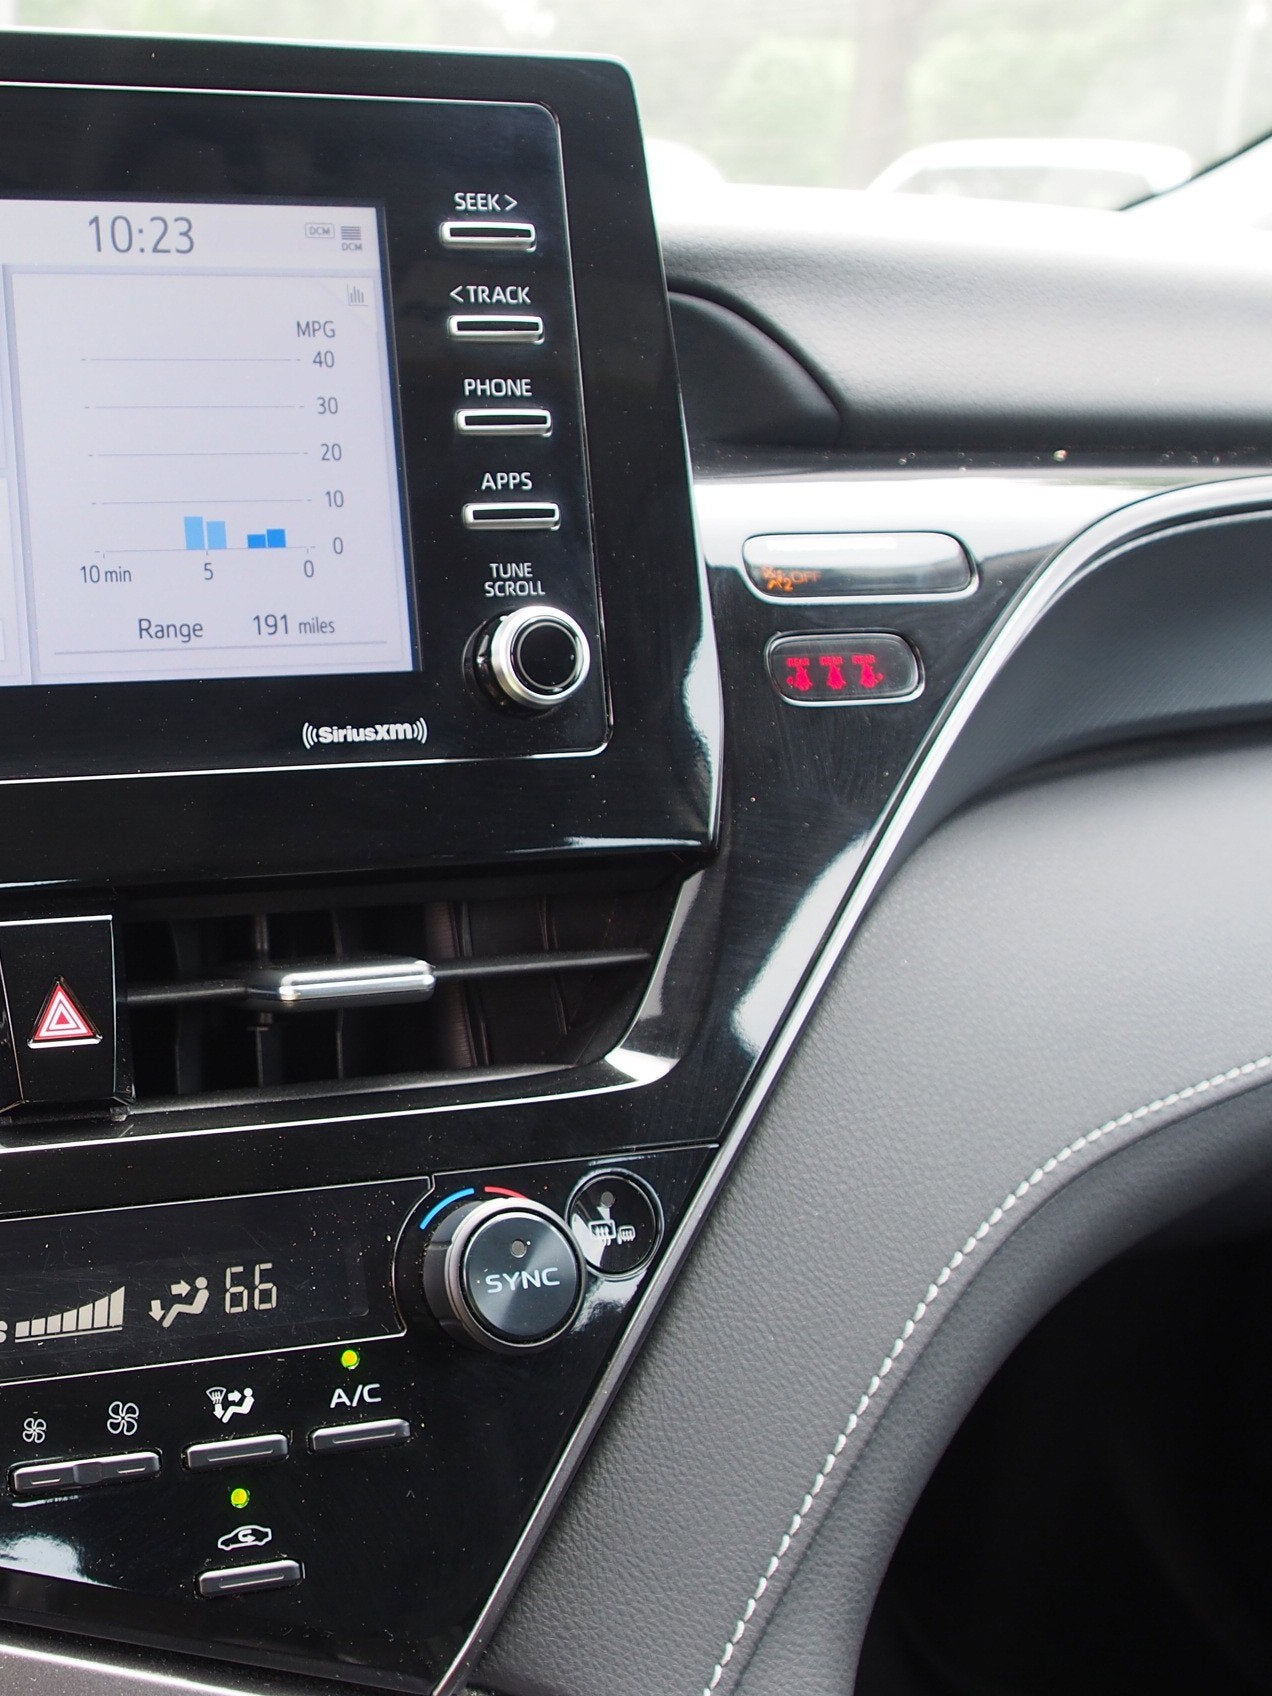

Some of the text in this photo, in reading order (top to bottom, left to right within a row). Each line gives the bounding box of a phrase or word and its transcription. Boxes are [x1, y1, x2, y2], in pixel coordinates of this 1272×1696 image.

[88, 214, 196, 254] 10:23
[308, 226, 331, 236] DCM
[341, 242, 363, 252] DCM
[295, 320, 337, 339] MPG
[312, 350, 336, 369] 40
[463, 378, 532, 397] PHONE
[317, 396, 339, 415] 30
[321, 443, 343, 461] 20
[480, 472, 533, 491] APPS
[325, 490, 345, 508] 10
[332, 536, 344, 556] 0
[80, 564, 133, 584] 10 min
[203, 562, 215, 581] 5
[303, 559, 315, 579] 0
[489, 562, 534, 579] TUNE
[484, 580, 546, 597] SCROLL
[137, 614, 335, 642] Range 191 miles
[224, 1262, 277, 1314] 66
[485, 1267, 560, 1294] SYNC
[330, 1383, 383, 1409] A/C
